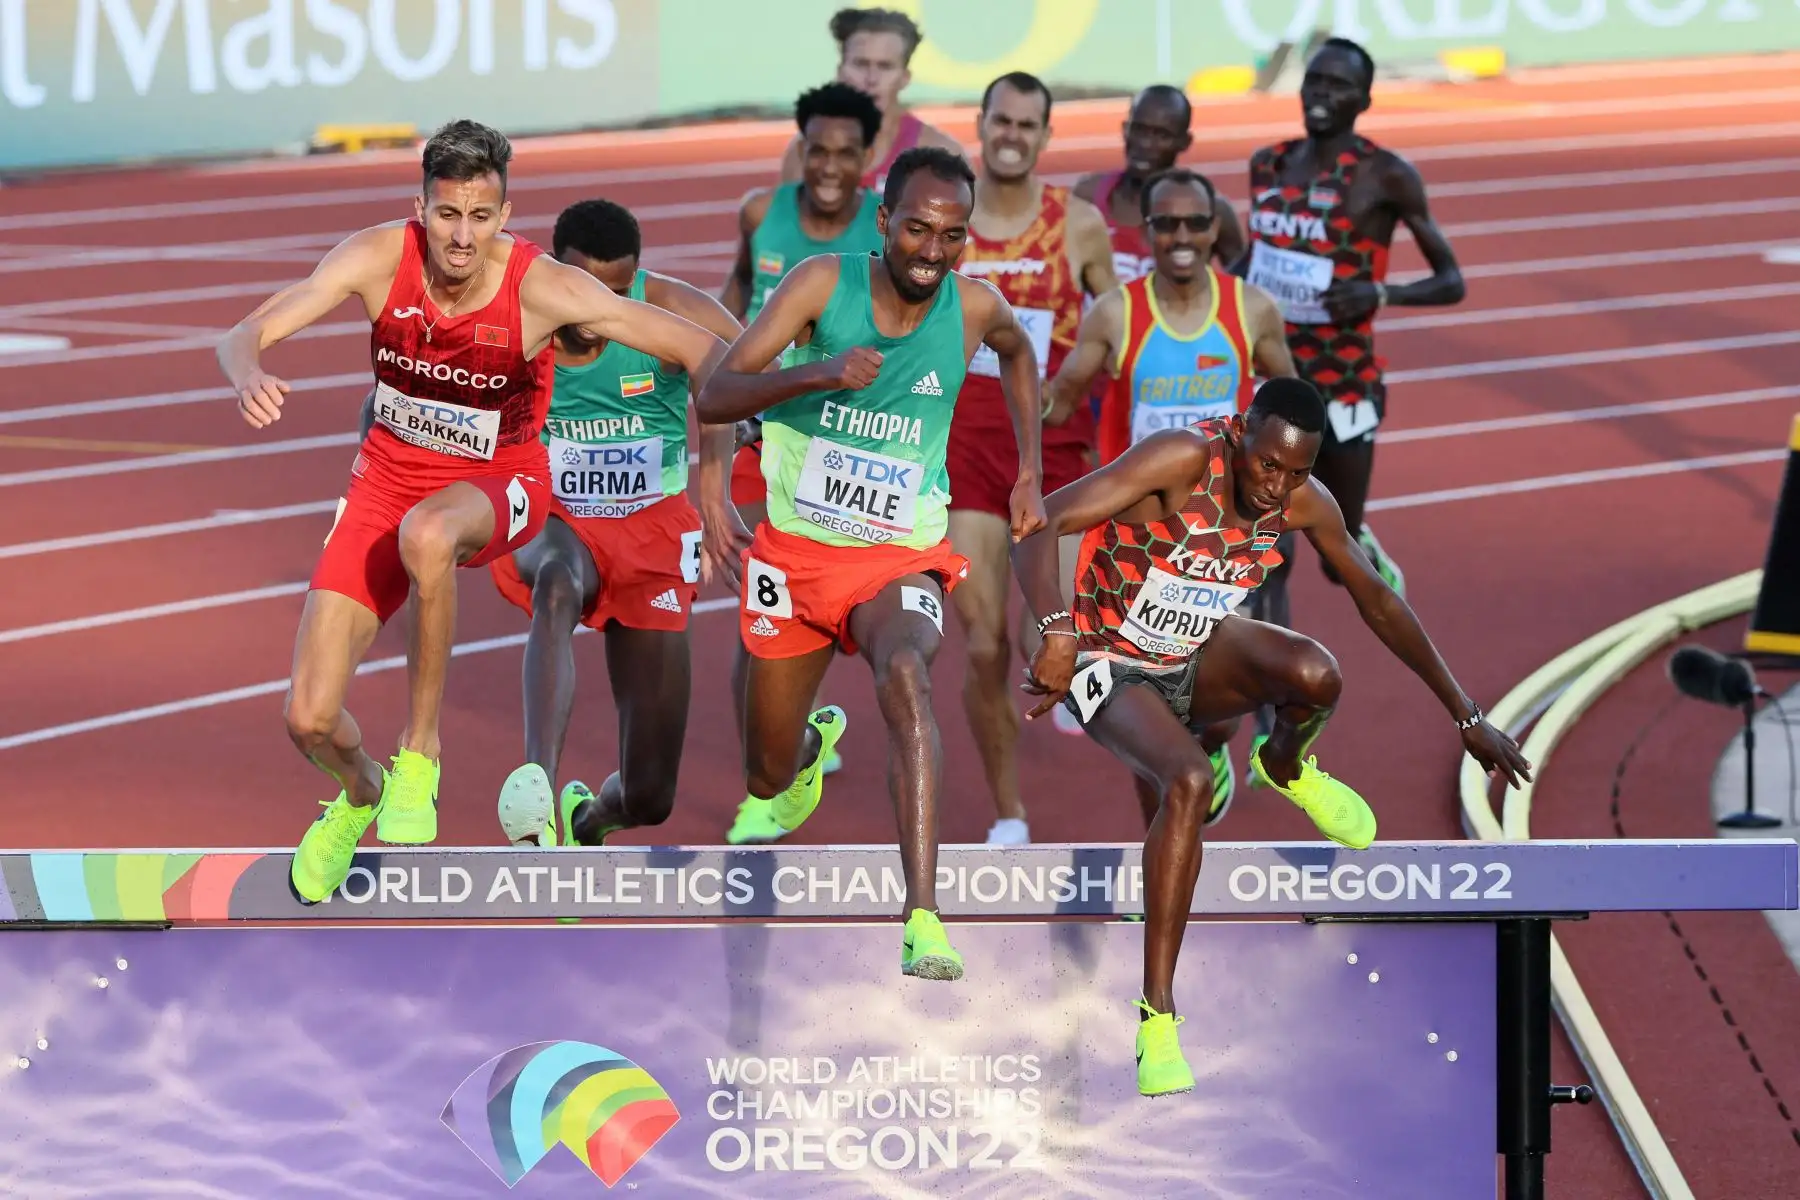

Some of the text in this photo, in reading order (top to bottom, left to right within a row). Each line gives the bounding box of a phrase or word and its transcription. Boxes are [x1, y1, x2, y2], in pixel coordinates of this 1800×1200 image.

[377, 347, 508, 390] MOROCCO
[380, 404, 490, 455] EL BAKKALI
[413, 402, 481, 430] TDK
[545, 414, 645, 441] ETHIOPIA
[819, 400, 923, 445] ETHIOPIA
[581, 445, 648, 466] TDK
[560, 470, 647, 495] GIRMA
[845, 454, 912, 489] TDK
[824, 476, 900, 521] WALE
[811, 511, 893, 543] OREGON22
[650, 599, 682, 613] adidas
[757, 574, 779, 607] 8
[1181, 586, 1234, 612] TDK
[918, 594, 938, 619] 8
[1086, 671, 1103, 701] 4
[300, 866, 472, 904] ORLD
[485, 866, 755, 904] ATHLETICS
[706, 1054, 1042, 1085] WORLD ATHLETICS
[706, 1088, 1042, 1121] CHAMPIONSHIPS
